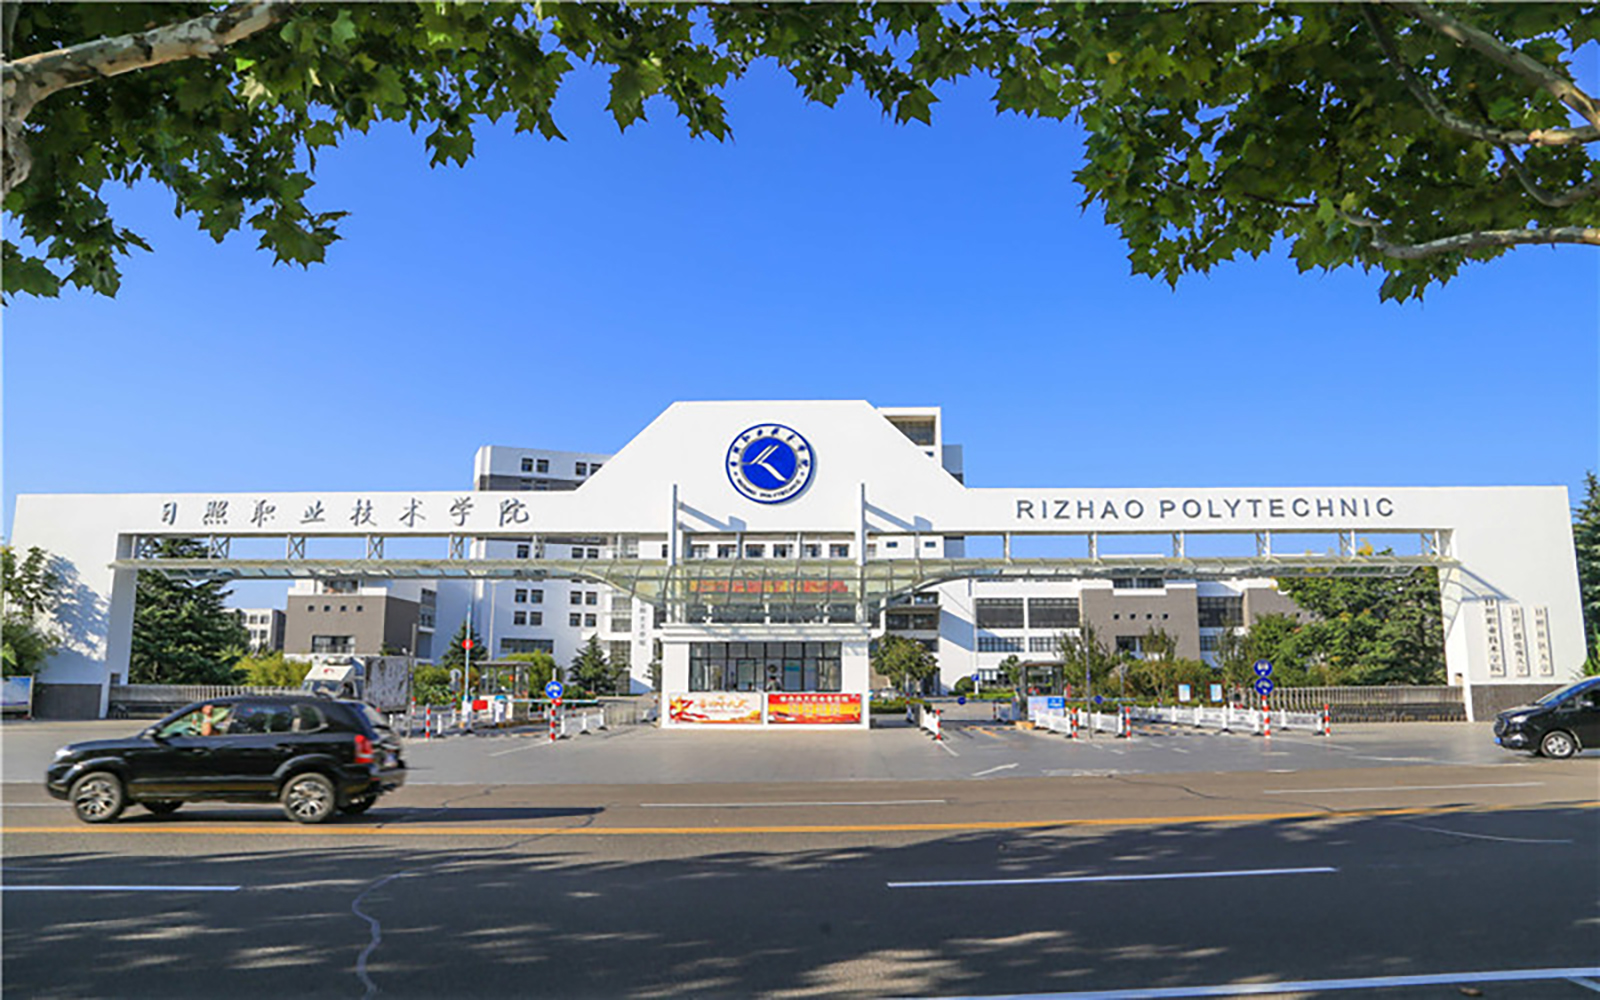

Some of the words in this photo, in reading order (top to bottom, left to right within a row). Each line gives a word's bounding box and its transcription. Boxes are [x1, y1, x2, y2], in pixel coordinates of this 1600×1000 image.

[161, 497, 529, 527] 日照职业技术学院
[1016, 499, 1144, 519] RIZHAO
[1159, 497, 1394, 518] POLYTECHNIC
